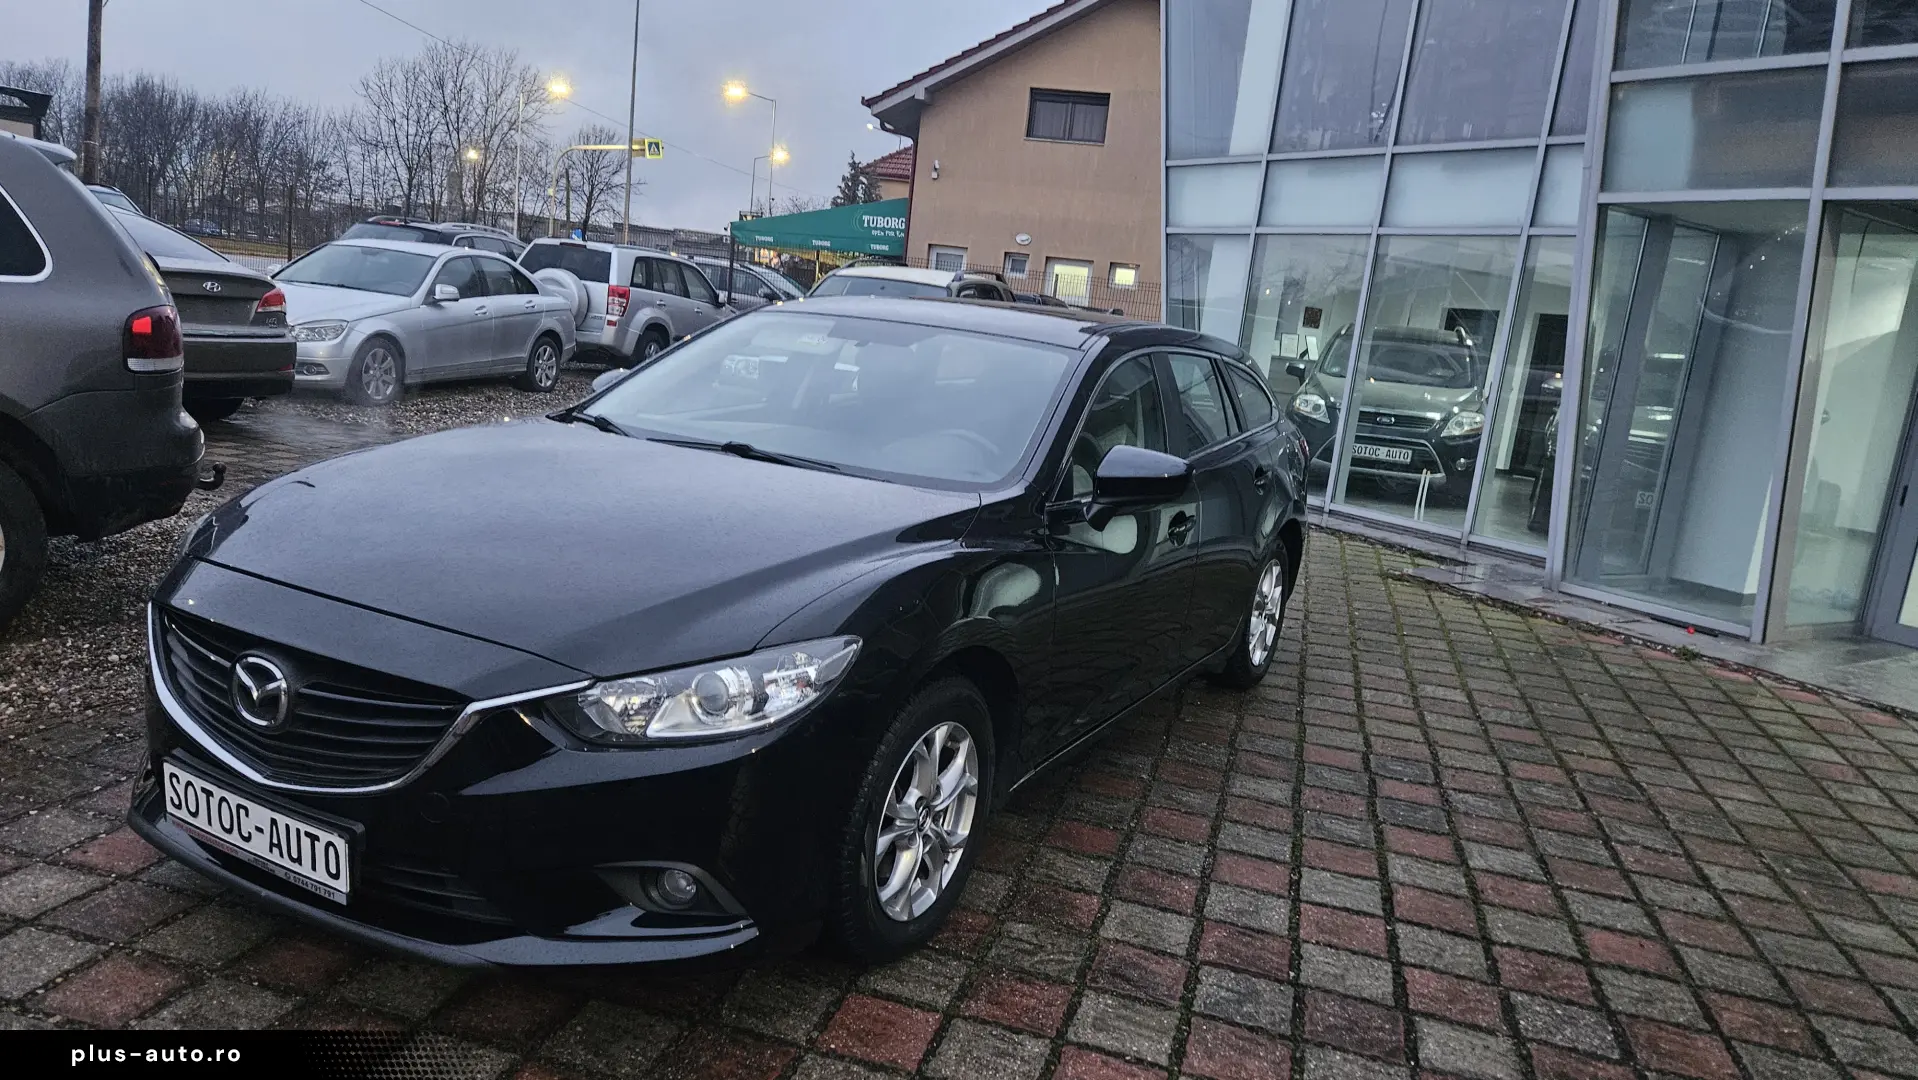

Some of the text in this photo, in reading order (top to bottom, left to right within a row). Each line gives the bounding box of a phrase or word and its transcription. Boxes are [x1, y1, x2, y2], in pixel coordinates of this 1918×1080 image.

[863, 215, 905, 229] TUBORG
[169, 772, 341, 881] SOTOC-AUTO
[292, 875, 309, 888] 0744
[310, 882, 322, 893] 791
